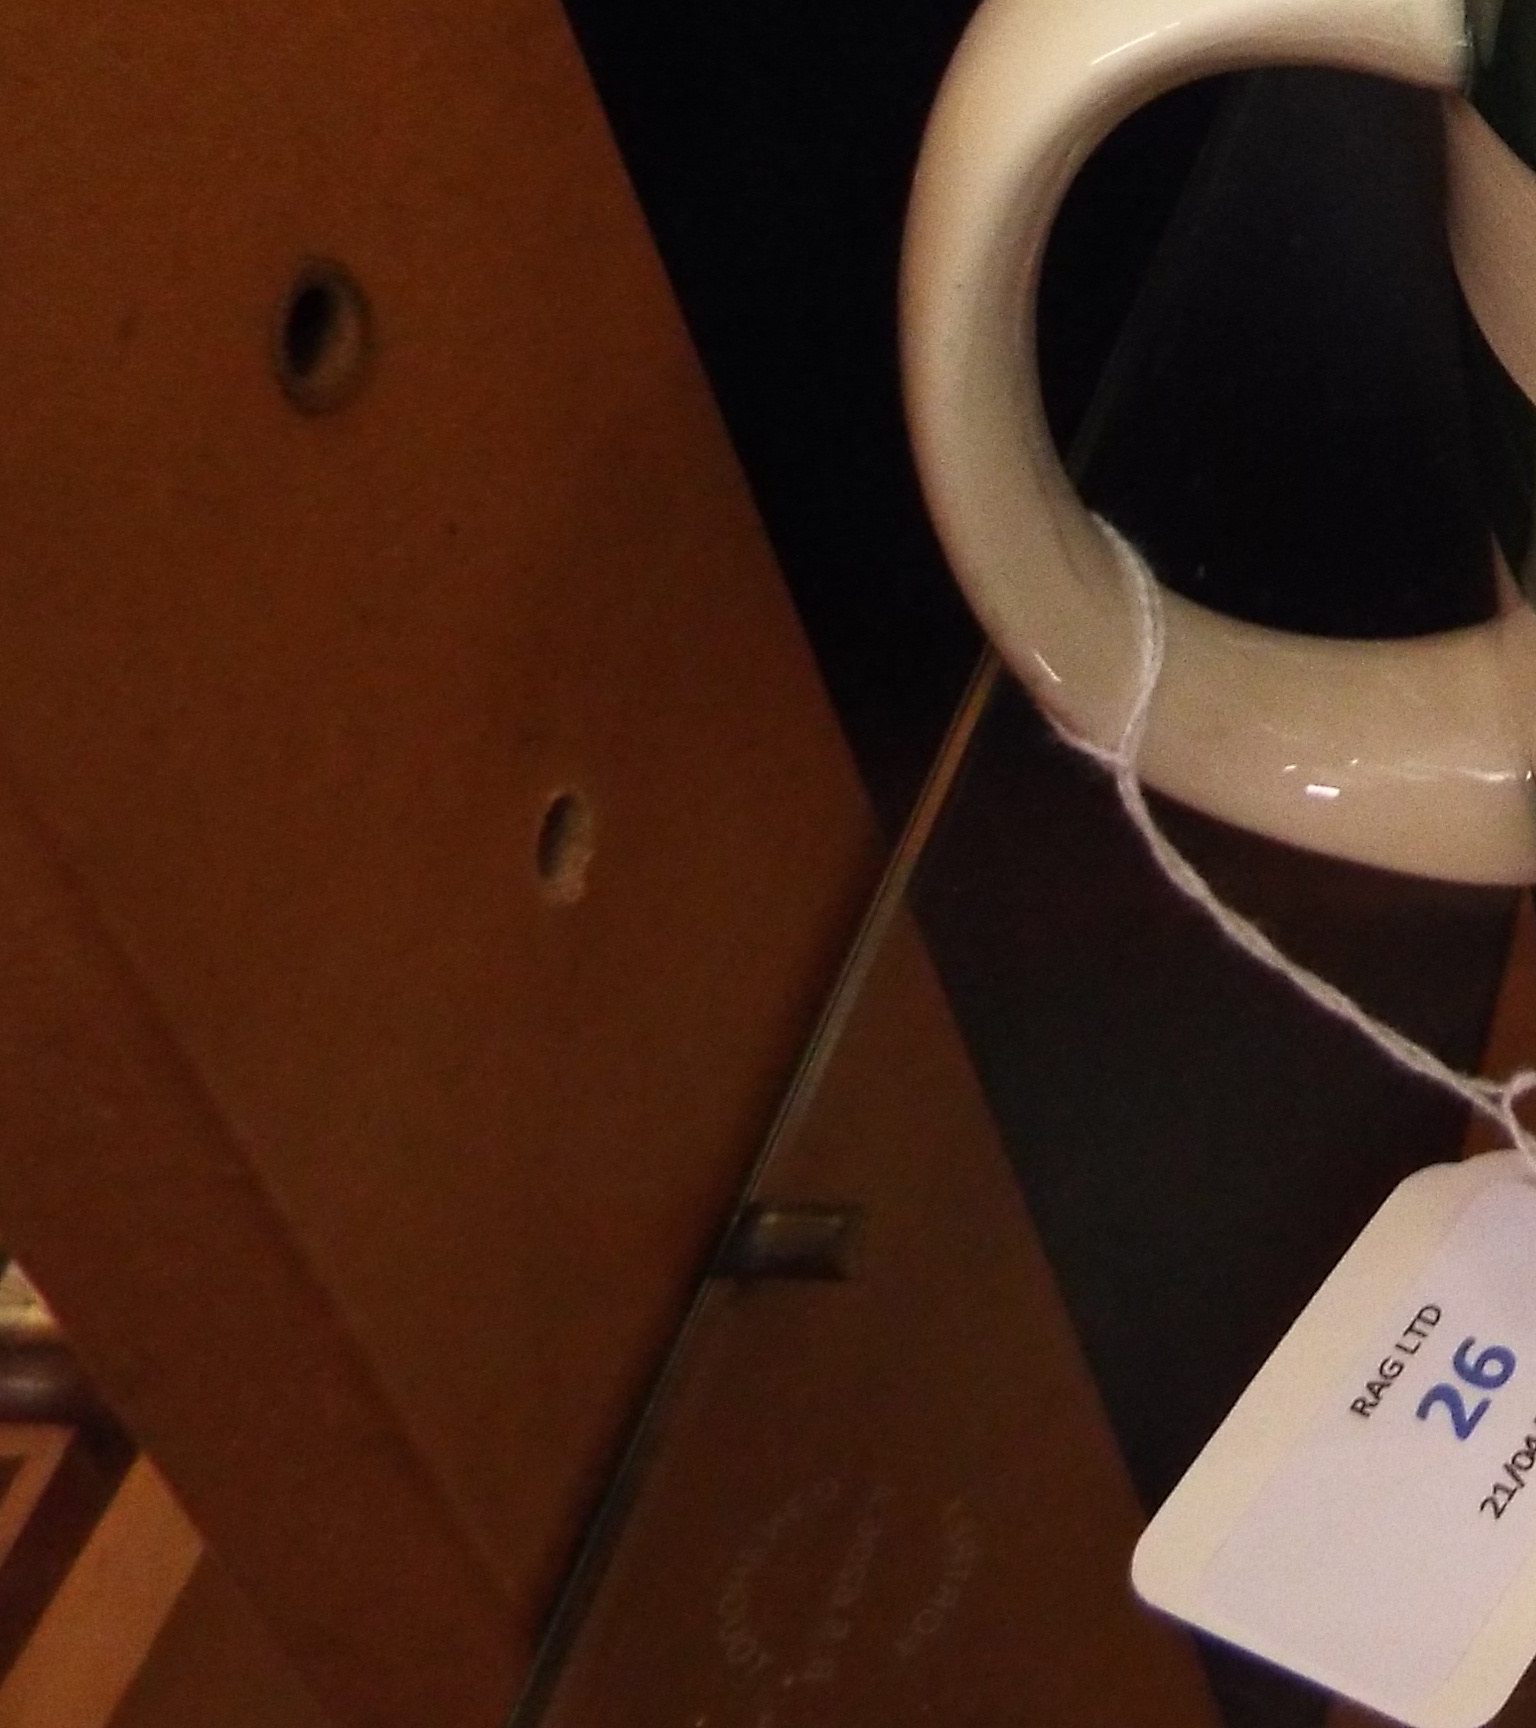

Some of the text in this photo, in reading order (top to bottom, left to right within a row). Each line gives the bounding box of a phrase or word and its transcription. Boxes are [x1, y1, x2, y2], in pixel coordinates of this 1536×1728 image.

[1350, 1302, 1443, 1418] RAG LTD
[1416, 1335, 1516, 1440] 26
